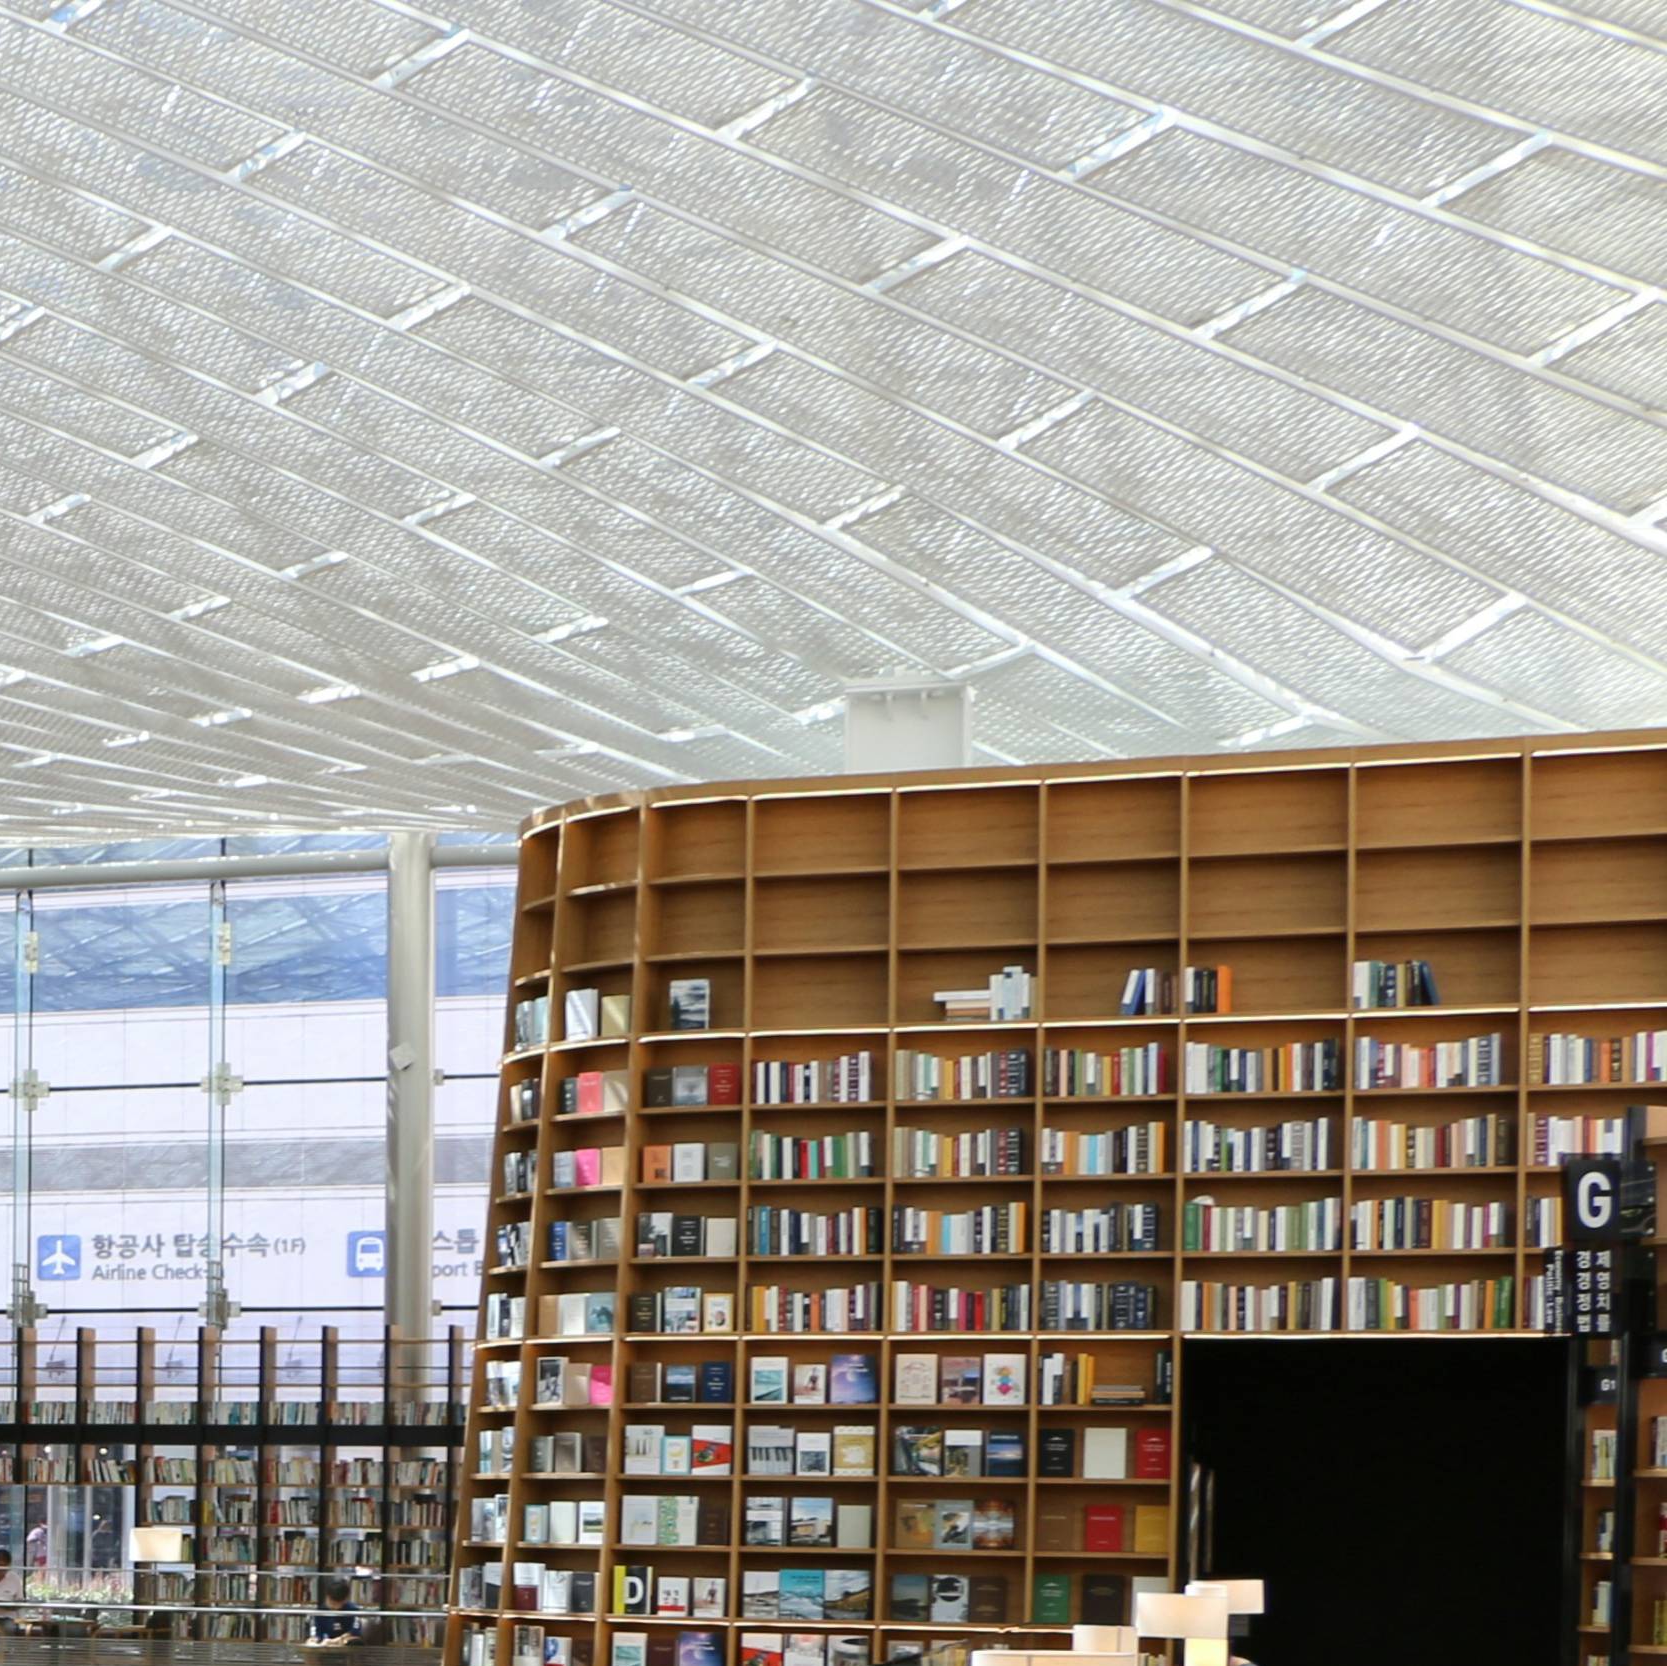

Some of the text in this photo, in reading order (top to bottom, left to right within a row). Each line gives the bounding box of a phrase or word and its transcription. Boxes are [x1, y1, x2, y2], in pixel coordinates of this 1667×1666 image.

[1577, 1171, 1612, 1228] G
[92, 1234, 165, 1259] 항공사
[274, 1238, 307, 1256] (1F)
[92, 1263, 147, 1281] Airline
[624, 1576, 644, 1605] D
